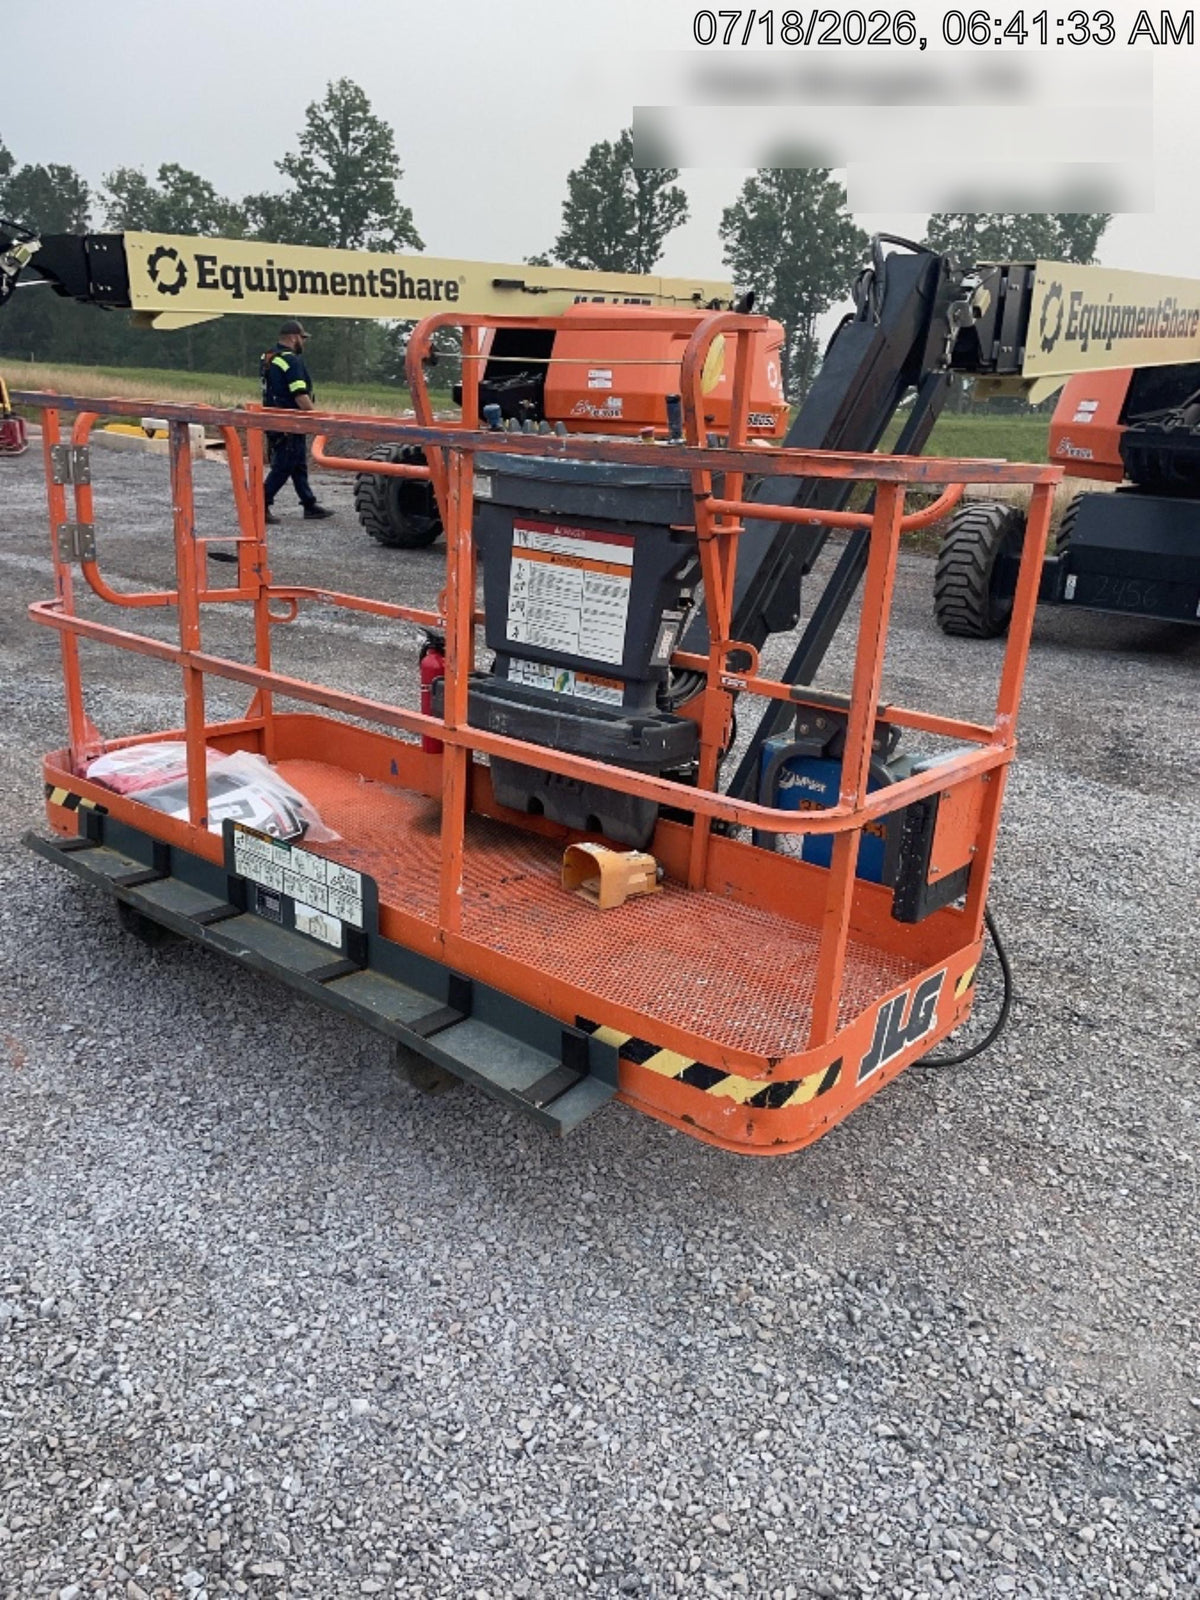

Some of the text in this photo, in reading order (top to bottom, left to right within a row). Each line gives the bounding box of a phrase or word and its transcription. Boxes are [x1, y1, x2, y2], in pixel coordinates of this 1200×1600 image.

[194, 254, 459, 301] EquipmentShare
[1065, 291, 1200, 352] EquipmentShare
[1092, 575, 1159, 608] 2456
[856, 967, 947, 1087] JLG
